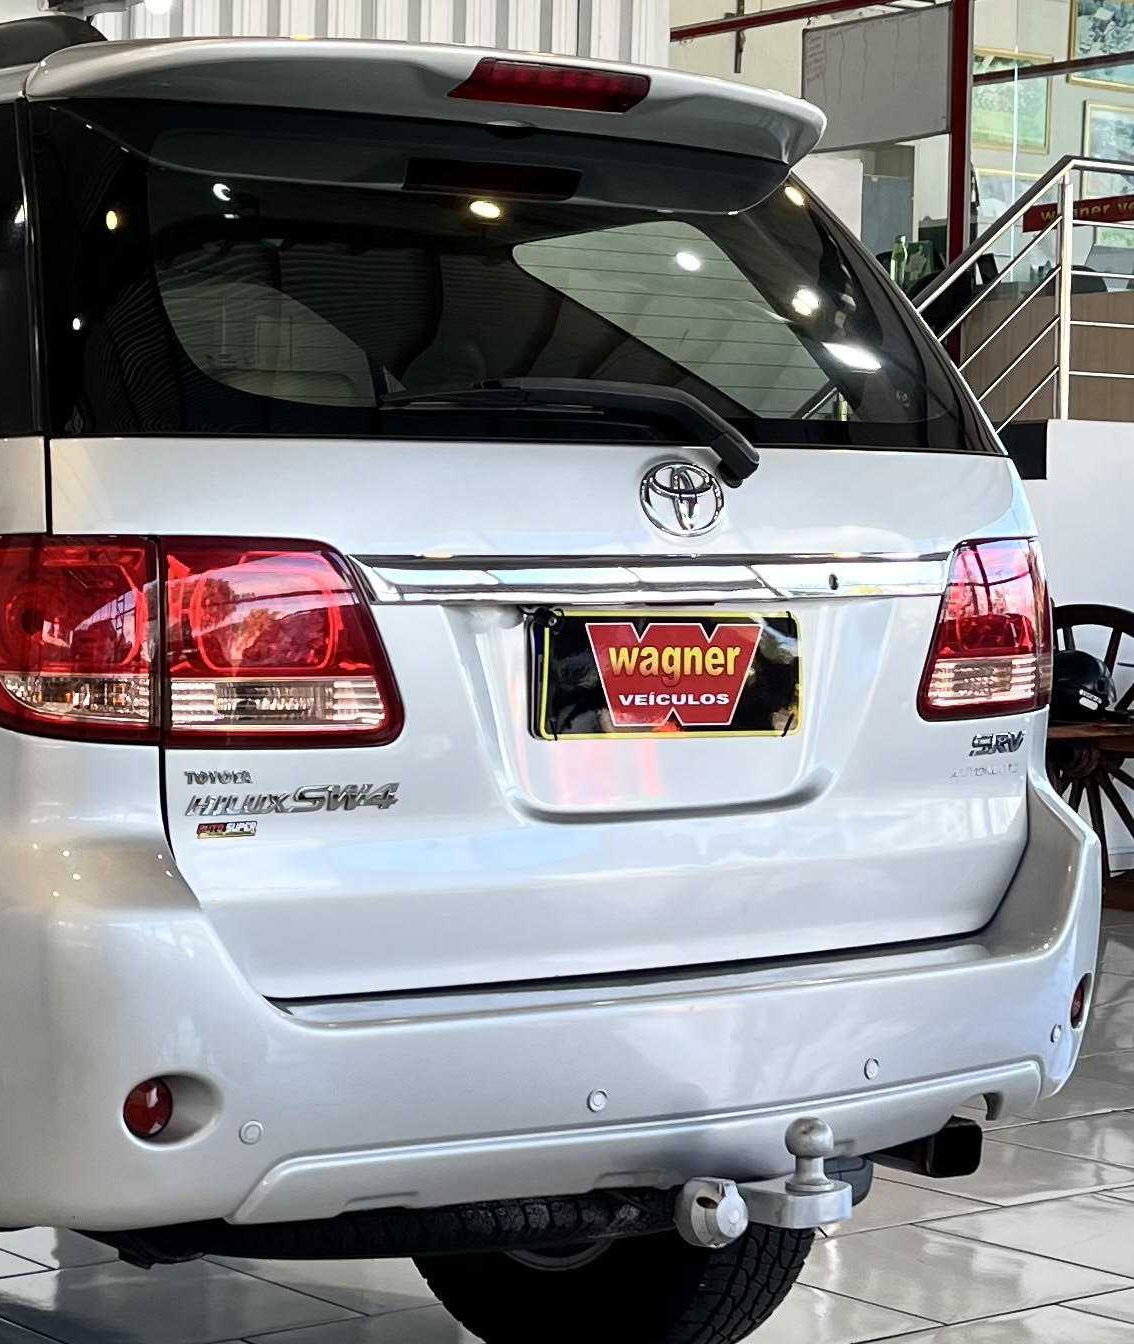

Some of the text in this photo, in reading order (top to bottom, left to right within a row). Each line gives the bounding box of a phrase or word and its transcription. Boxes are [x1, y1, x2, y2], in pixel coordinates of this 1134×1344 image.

[608, 644, 742, 687] wagner
[618, 691, 730, 706] VEÍCULOS
[969, 731, 1023, 756] SRV
